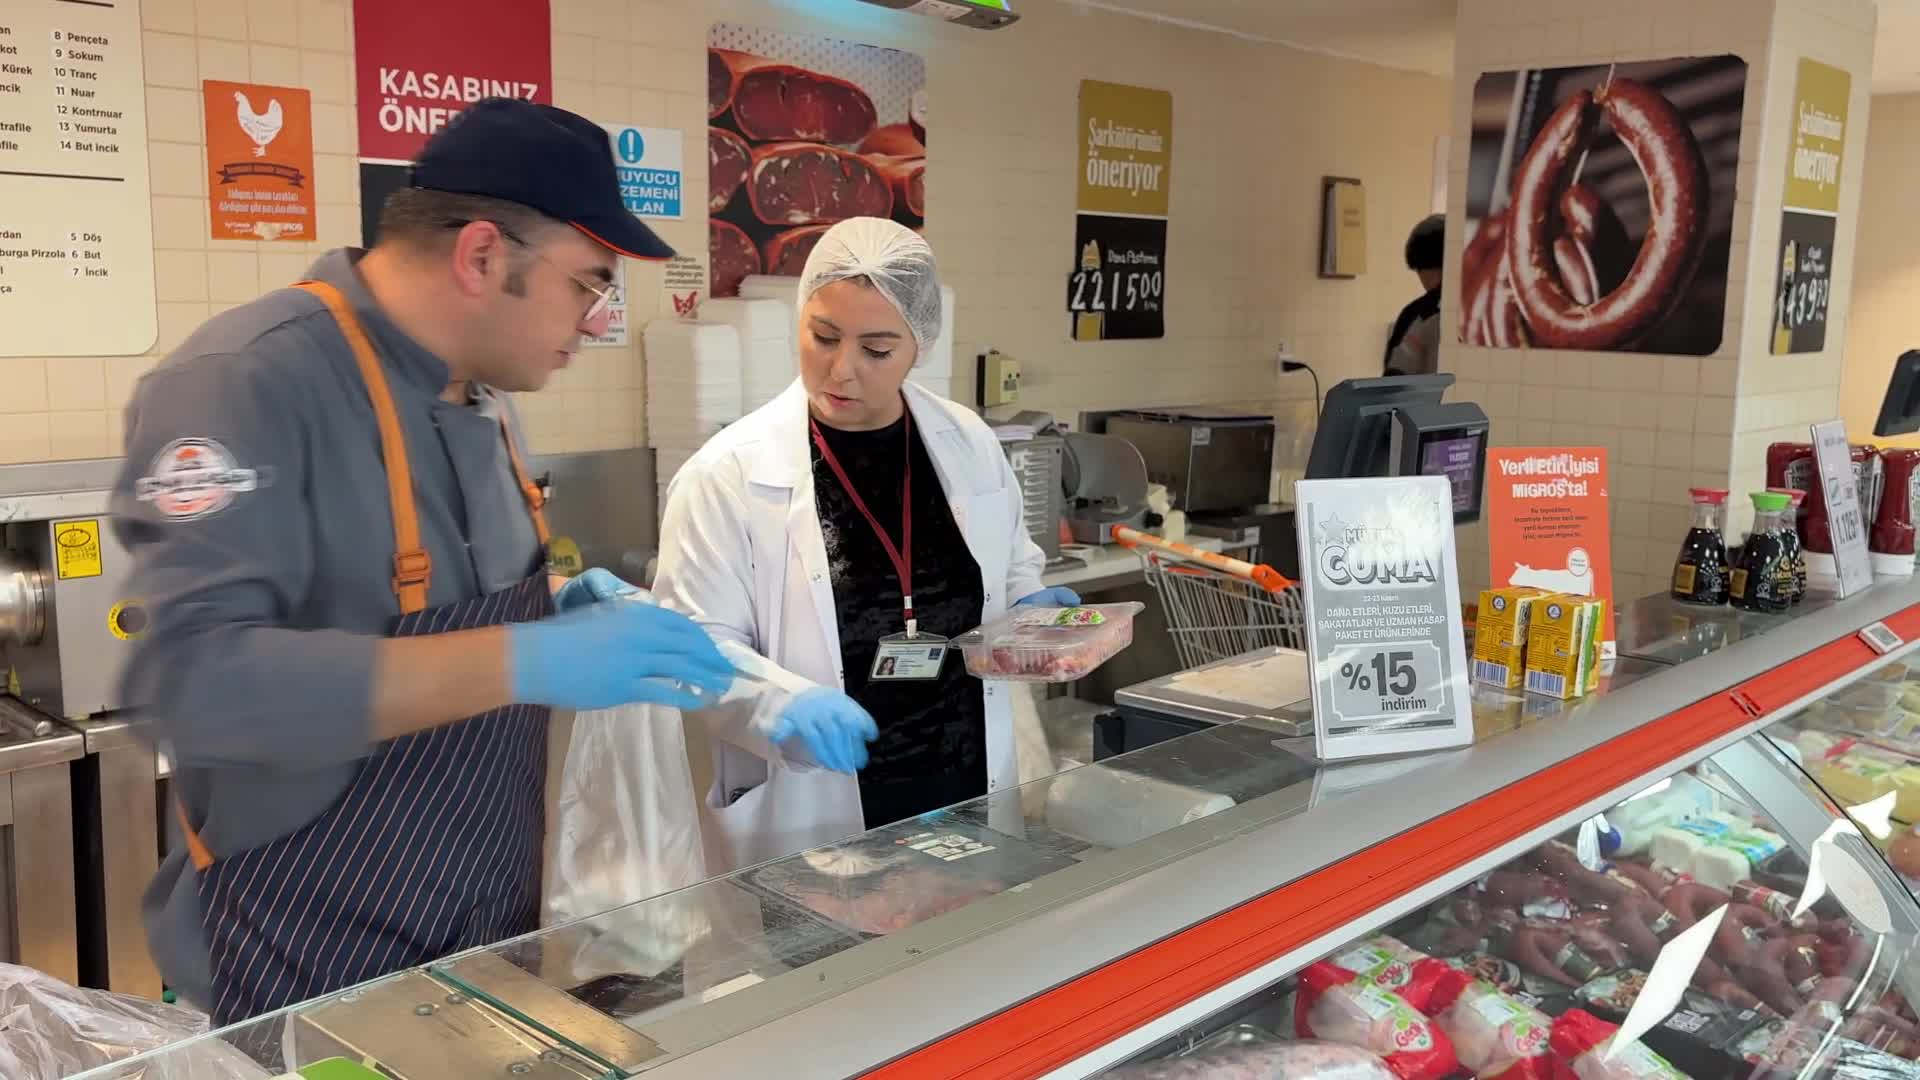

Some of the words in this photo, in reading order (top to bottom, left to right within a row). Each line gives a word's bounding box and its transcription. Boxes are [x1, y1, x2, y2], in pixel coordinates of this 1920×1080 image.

[54, 31, 61, 40] 8
[67, 32, 108, 46] Pençeta
[55, 48, 62, 58] 9
[68, 50, 103, 62] Sokum
[2, 63, 32, 75] Kürek
[54, 67, 66, 77] 10
[69, 69, 97, 80] Tranç
[56, 86, 65, 95] 11
[71, 87, 95, 98] Nuar
[57, 105, 67, 114] 12
[72, 106, 122, 119] Kontrnuar
[378, 97, 463, 134] ÖNE
[59, 122, 69, 131] 13
[74, 123, 117, 135] Yumurta
[60, 140, 71, 149] 14
[75, 141, 93, 151] But
[1087, 151, 1164, 197] öneriyor
[71, 233, 77, 241] 5
[83, 233, 102, 243] Döş
[31, 249, 66, 259] Pirzola
[71, 250, 79, 259] 6
[84, 251, 101, 259] But
[72, 267, 79, 276] 7
[1327, 607, 1351, 617] DANA
[1353, 604, 1381, 616] ETLERİ,
[1383, 606, 1405, 615] KUZU
[1406, 602, 1434, 614] ETLERİ,
[1318, 620, 1372, 629] SAKATATLAR
[1374, 618, 1385, 627] VE
[1386, 617, 1417, 626] UZMAN
[1418, 615, 1446, 625] KASAP
[1335, 630, 1361, 640] PAKET
[1363, 629, 1373, 638] ET
[1374, 625, 1431, 638] ÜRÜNLERİNDE
[1340, 651, 1417, 697] %15
[1381, 696, 1427, 711] indirim
